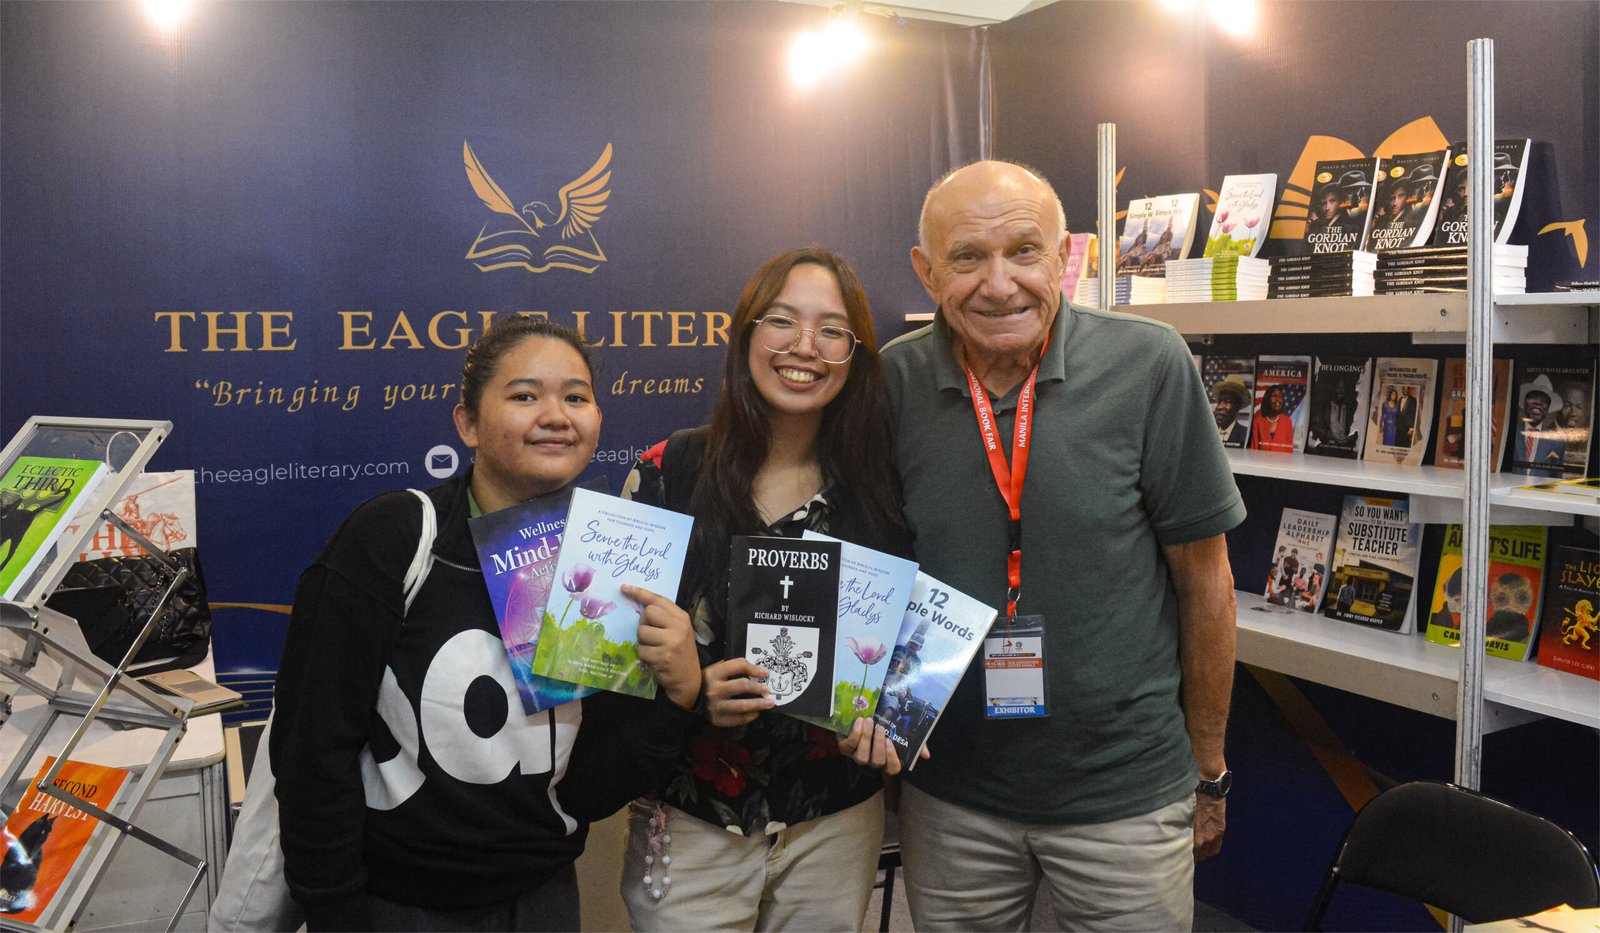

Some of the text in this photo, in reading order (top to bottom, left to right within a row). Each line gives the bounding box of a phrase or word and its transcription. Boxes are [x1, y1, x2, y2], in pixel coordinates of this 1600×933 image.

[1145, 202, 1152, 210] 12
[1171, 199, 1179, 208] 12
[1390, 221, 1405, 229] THE
[1307, 232, 1358, 244] GORDIAN
[1371, 226, 1417, 240] GORDIAN
[1447, 232, 1469, 244] KN
[1313, 242, 1348, 254] KNOT
[1374, 237, 1405, 249] KNOT
[155, 311, 297, 352] THE
[337, 310, 548, 351] EAG
[1263, 369, 1302, 378] AMERICA
[1321, 364, 1363, 373] BELONGING
[383, 383, 456, 411] your
[611, 371, 705, 395] dreams
[979, 407, 992, 432] BOOK
[1018, 414, 1028, 449] MANILA
[985, 433, 997, 452] FAIR
[22, 464, 84, 478] ECLECTIC
[12, 474, 75, 493] THIRD
[1354, 505, 1405, 522] SO YOU WANT
[1283, 522, 1330, 536] LEADERSHIP
[1297, 518, 1319, 528] DAILY
[580, 519, 672, 560] Serve the Lord
[1286, 530, 1324, 543] ALPHABET
[1347, 522, 1408, 543] SUBSTITUTE
[1352, 537, 1399, 557] TEACHER
[1511, 540, 1542, 561] LIFE
[588, 549, 660, 582] with Gladys
[747, 548, 829, 571] PROVERBS
[1565, 563, 1576, 571] THE
[531, 561, 557, 578] Acti
[845, 577, 895, 605] the Lord
[928, 588, 950, 610] 12
[754, 611, 816, 623] RICHARD WISLOCKY
[931, 610, 975, 641] Words
[994, 706, 1036, 715] EXHIBITOR
[892, 734, 909, 748] DESA
[53, 778, 98, 799] SECOND
